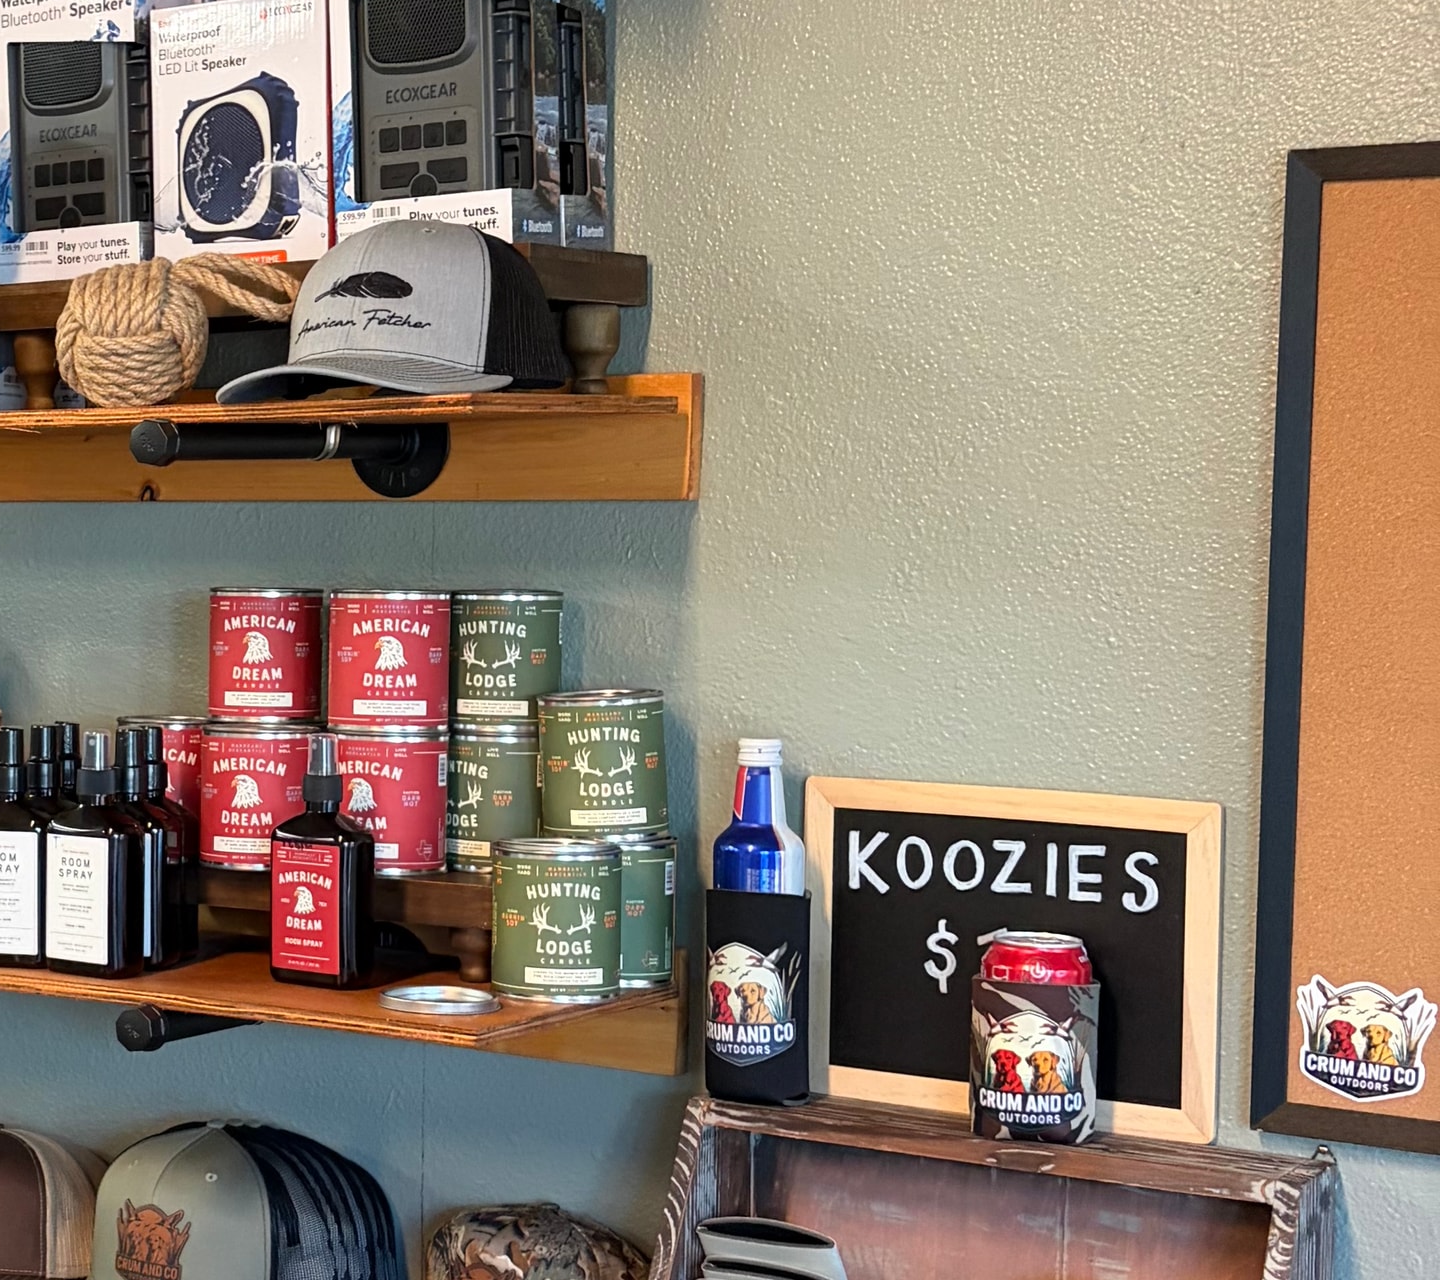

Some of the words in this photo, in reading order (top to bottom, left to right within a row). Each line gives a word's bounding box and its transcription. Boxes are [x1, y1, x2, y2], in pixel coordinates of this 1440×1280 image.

[159, 61, 181, 76] LED
[184, 60, 199, 73] Lit
[201, 56, 246, 72] Speaker
[385, 82, 458, 105] ECOXGEAR
[38, 124, 98, 144] ECOXGEAR
[409, 211, 433, 221] Play
[435, 208, 460, 220] your
[463, 204, 499, 218] tunes.
[57, 241, 77, 254] Play
[78, 239, 98, 252] your
[100, 236, 130, 248] tunes.
[57, 253, 81, 266] Store
[83, 252, 103, 265] your
[105, 248, 130, 261] stuff.
[224, 615, 296, 634] AMERICAN
[352, 617, 430, 638] AMERICAN
[459, 620, 527, 638] HUNTING
[232, 666, 283, 681] DREAM
[363, 672, 417, 689] DREAM
[465, 673, 517, 688] LODGE
[567, 727, 641, 745] HUNTING
[213, 757, 287, 776] AMERICAN
[338, 761, 403, 781] MERICAN
[449, 760, 488, 779] NTING
[579, 781, 635, 797] LODGE
[221, 810, 273, 826] DREAM
[61, 856, 90, 868] ROOM
[58, 868, 93, 881] SPRAY
[278, 871, 332, 890] AMERICAN
[847, 829, 1160, 914] KOOZIES
[526, 882, 601, 900] HUNTING
[286, 916, 323, 931] DREAM
[536, 939, 593, 956] LODGE
[737, 1023, 770, 1042] AND
[773, 1022, 793, 1042] CO
[716, 1043, 771, 1055] OUTDOORS
[1306, 1053, 1354, 1077] CRUM
[1357, 1062, 1391, 1082] AND
[1393, 1067, 1416, 1086] CO
[1330, 1075, 1390, 1093] OUTDOORS
[979, 1089, 1022, 1113] CRUM
[1025, 1090, 1061, 1113] AND
[1063, 1091, 1082, 1113] CO
[998, 1111, 1061, 1125] OUTDOORS
[116, 1257, 142, 1272] CRUM
[143, 1261, 162, 1278] AND
[162, 1265, 178, 1280] CO
